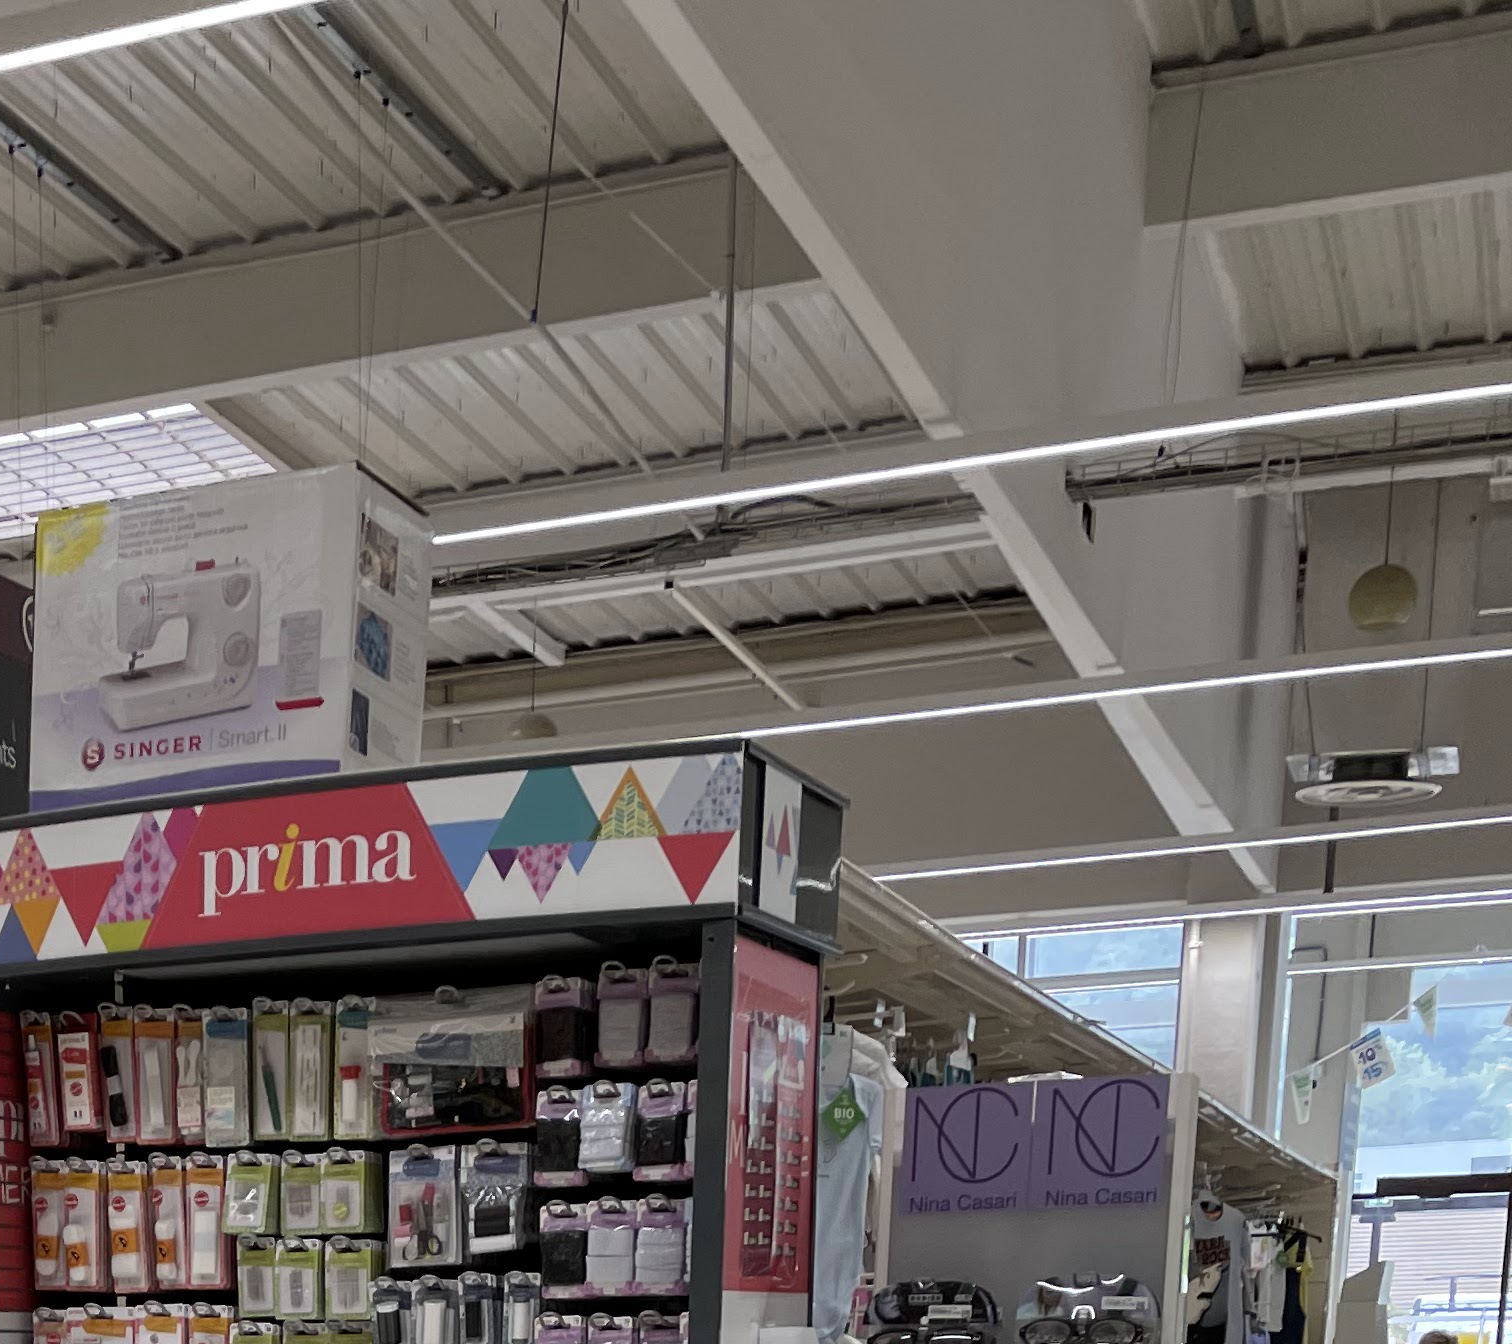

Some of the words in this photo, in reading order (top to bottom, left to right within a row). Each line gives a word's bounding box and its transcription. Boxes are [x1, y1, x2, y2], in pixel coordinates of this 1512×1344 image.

[114, 735, 202, 760] SINGER
[198, 824, 417, 917] prima
[834, 1108, 855, 1120] BIO
[909, 1194, 953, 1213] Nina
[957, 1191, 1018, 1212] Casari
[1045, 1190, 1088, 1208] Nina
[1093, 1186, 1157, 1206] Casari
